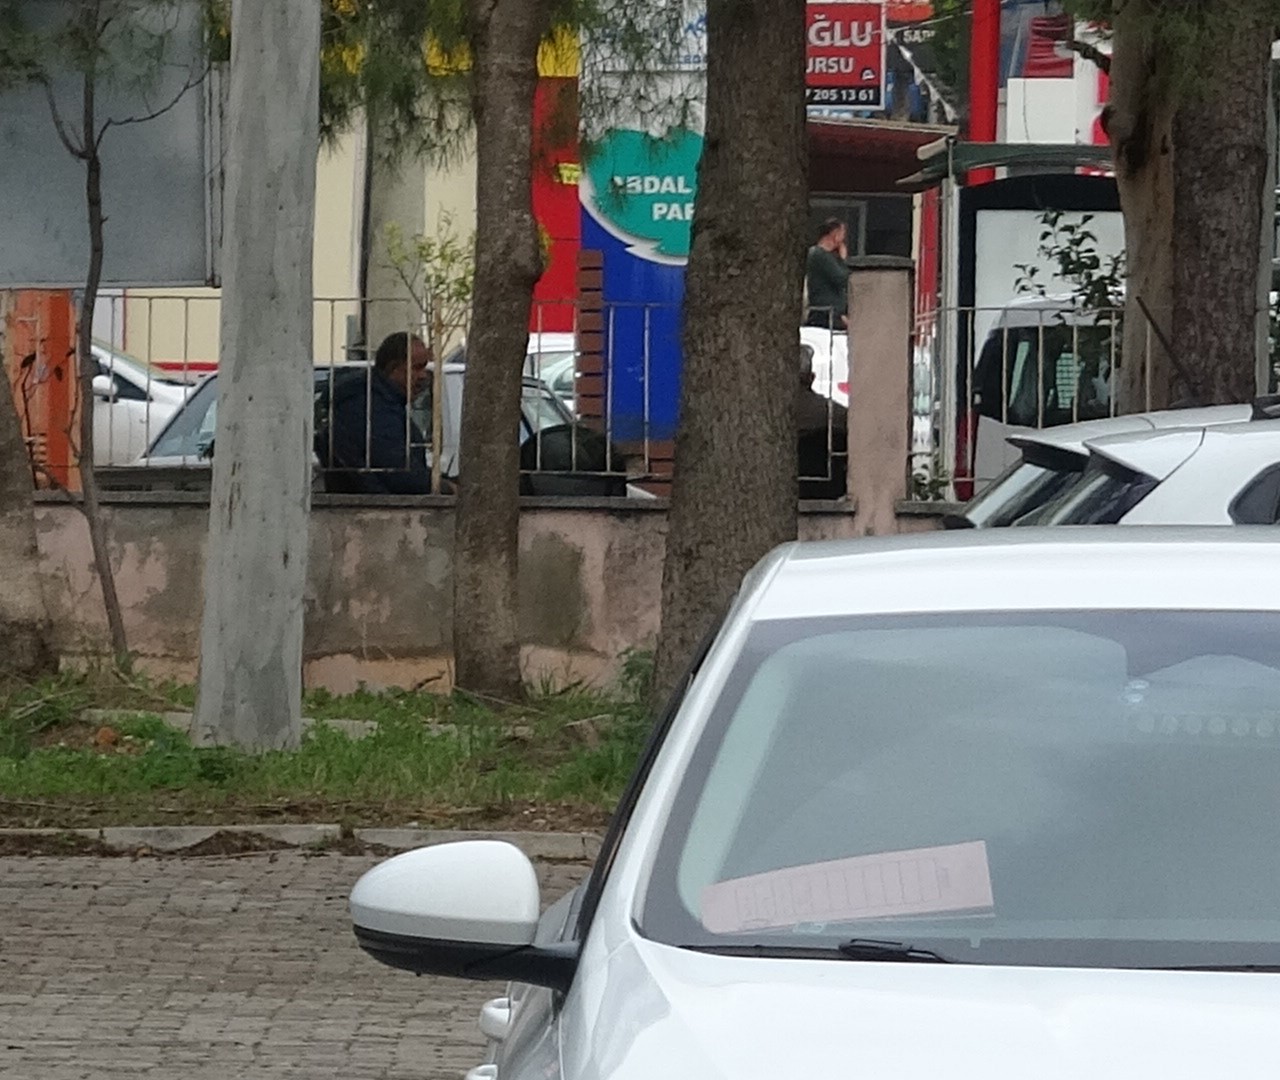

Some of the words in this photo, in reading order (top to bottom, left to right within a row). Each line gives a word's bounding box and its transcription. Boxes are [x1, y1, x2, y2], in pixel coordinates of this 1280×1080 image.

[813, 89, 838, 101] 205
[841, 89, 856, 101] 13
[859, 89, 874, 101] 61
